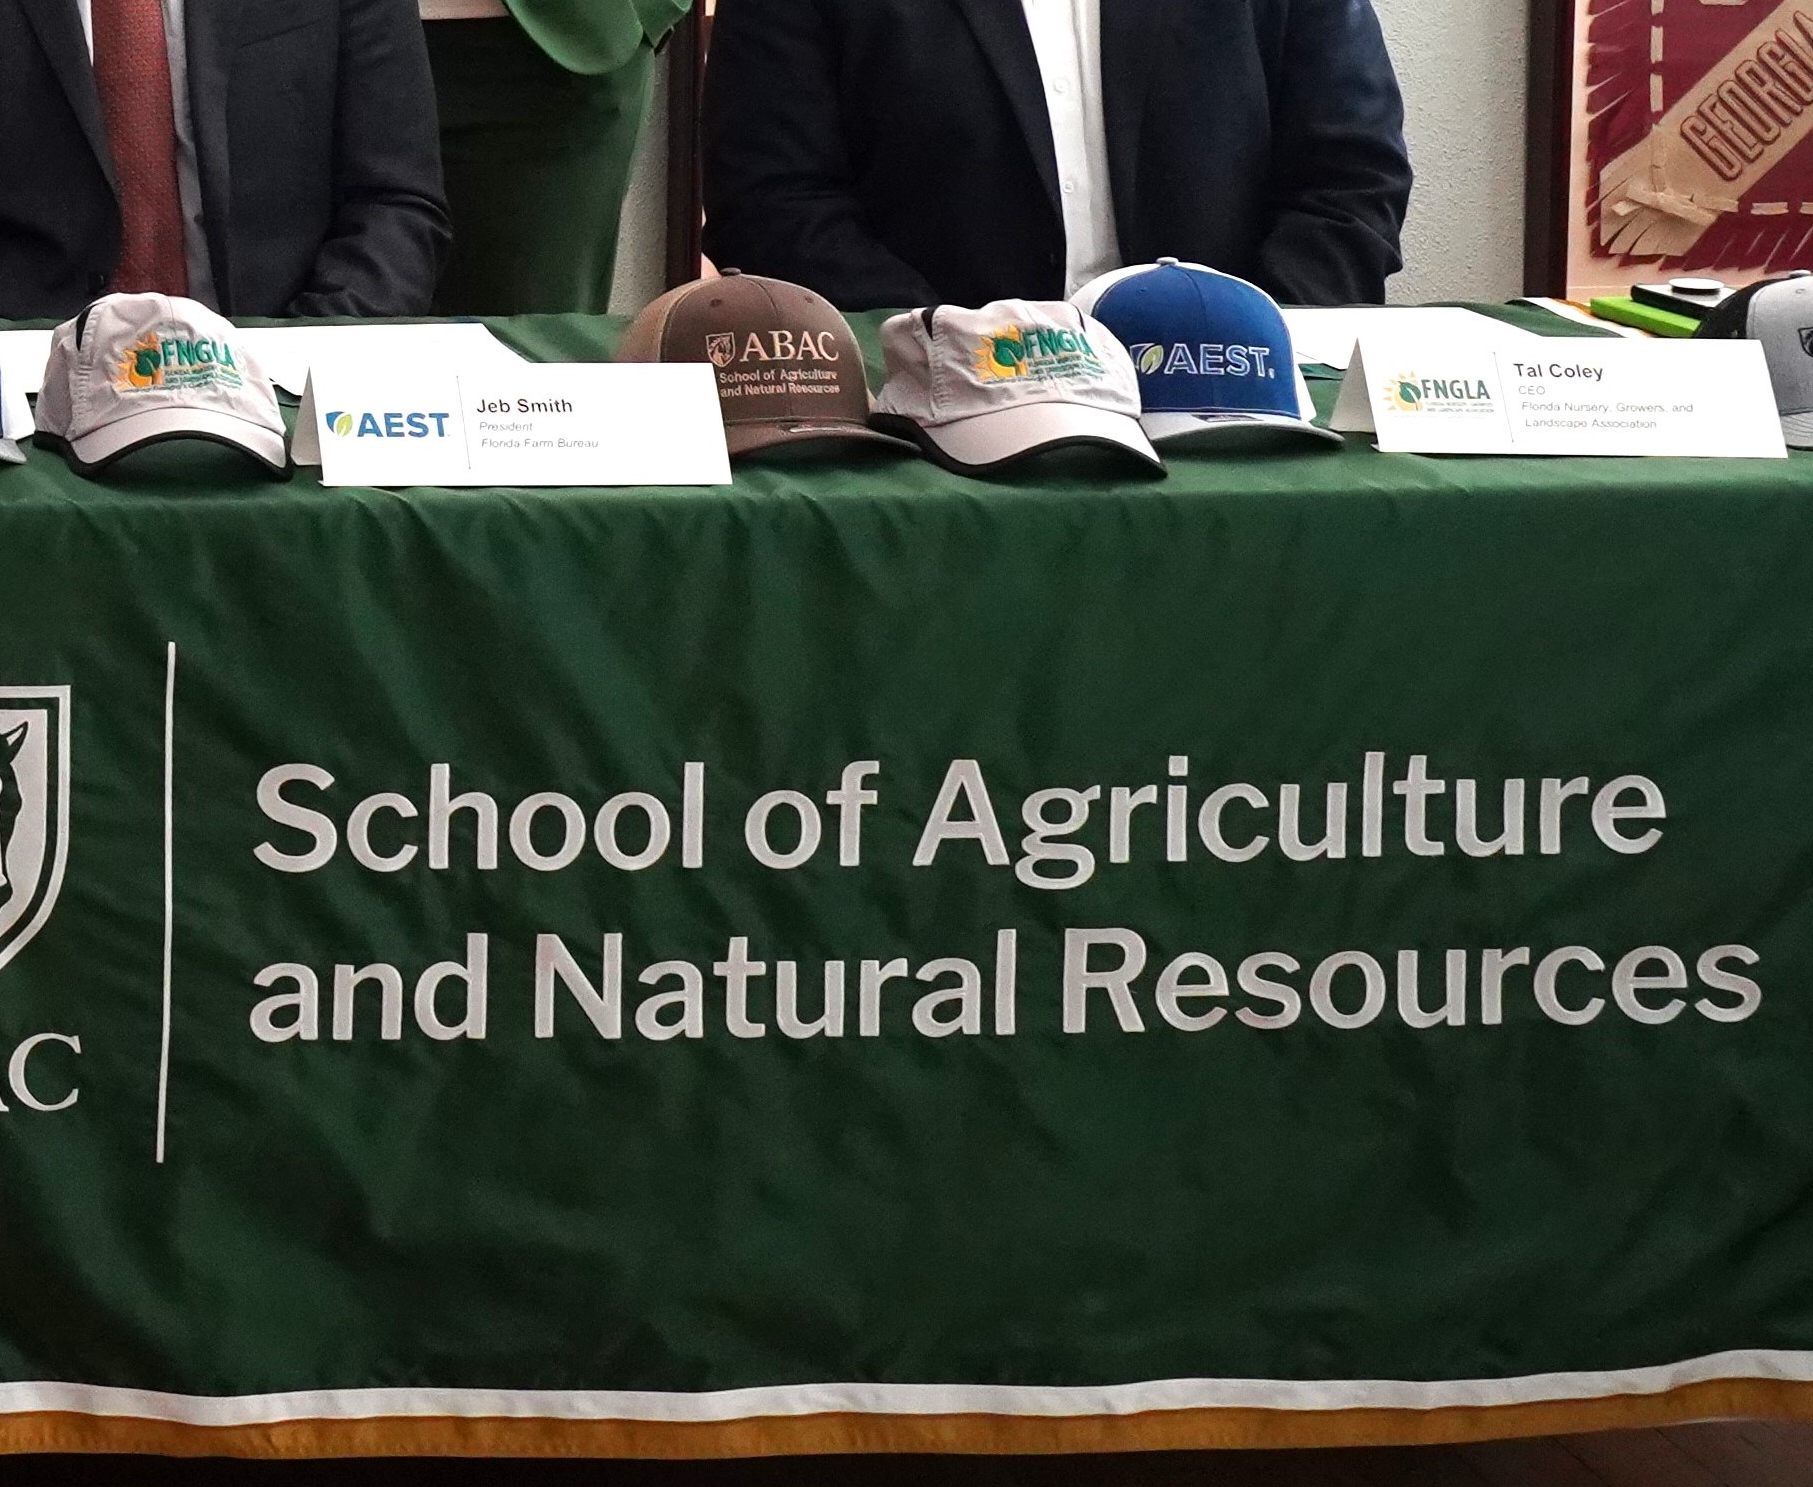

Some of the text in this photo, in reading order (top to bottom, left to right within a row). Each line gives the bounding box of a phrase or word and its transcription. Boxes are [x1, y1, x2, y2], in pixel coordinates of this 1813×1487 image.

[1680, 10, 1813, 181] GEORGI
[739, 330, 839, 362] ABAC
[719, 368, 838, 383] School of Agriculture
[1513, 363, 1603, 382] Tal Coley
[720, 382, 840, 397] and Natural Resources
[1423, 379, 1491, 400] FNGLA
[1518, 386, 1546, 395] CEO
[477, 398, 573, 413] Jeb Smith
[1522, 401, 1694, 414] Florida Nursery, Growers, and
[357, 412, 450, 438] AEST
[479, 421, 533, 432] President
[1525, 419, 1658, 430] Landscape Association
[481, 438, 599, 448] Florida Farm Bureau
[254, 750, 1667, 890] School of Agriculture
[250, 926, 1762, 1043] and Natural Resources
